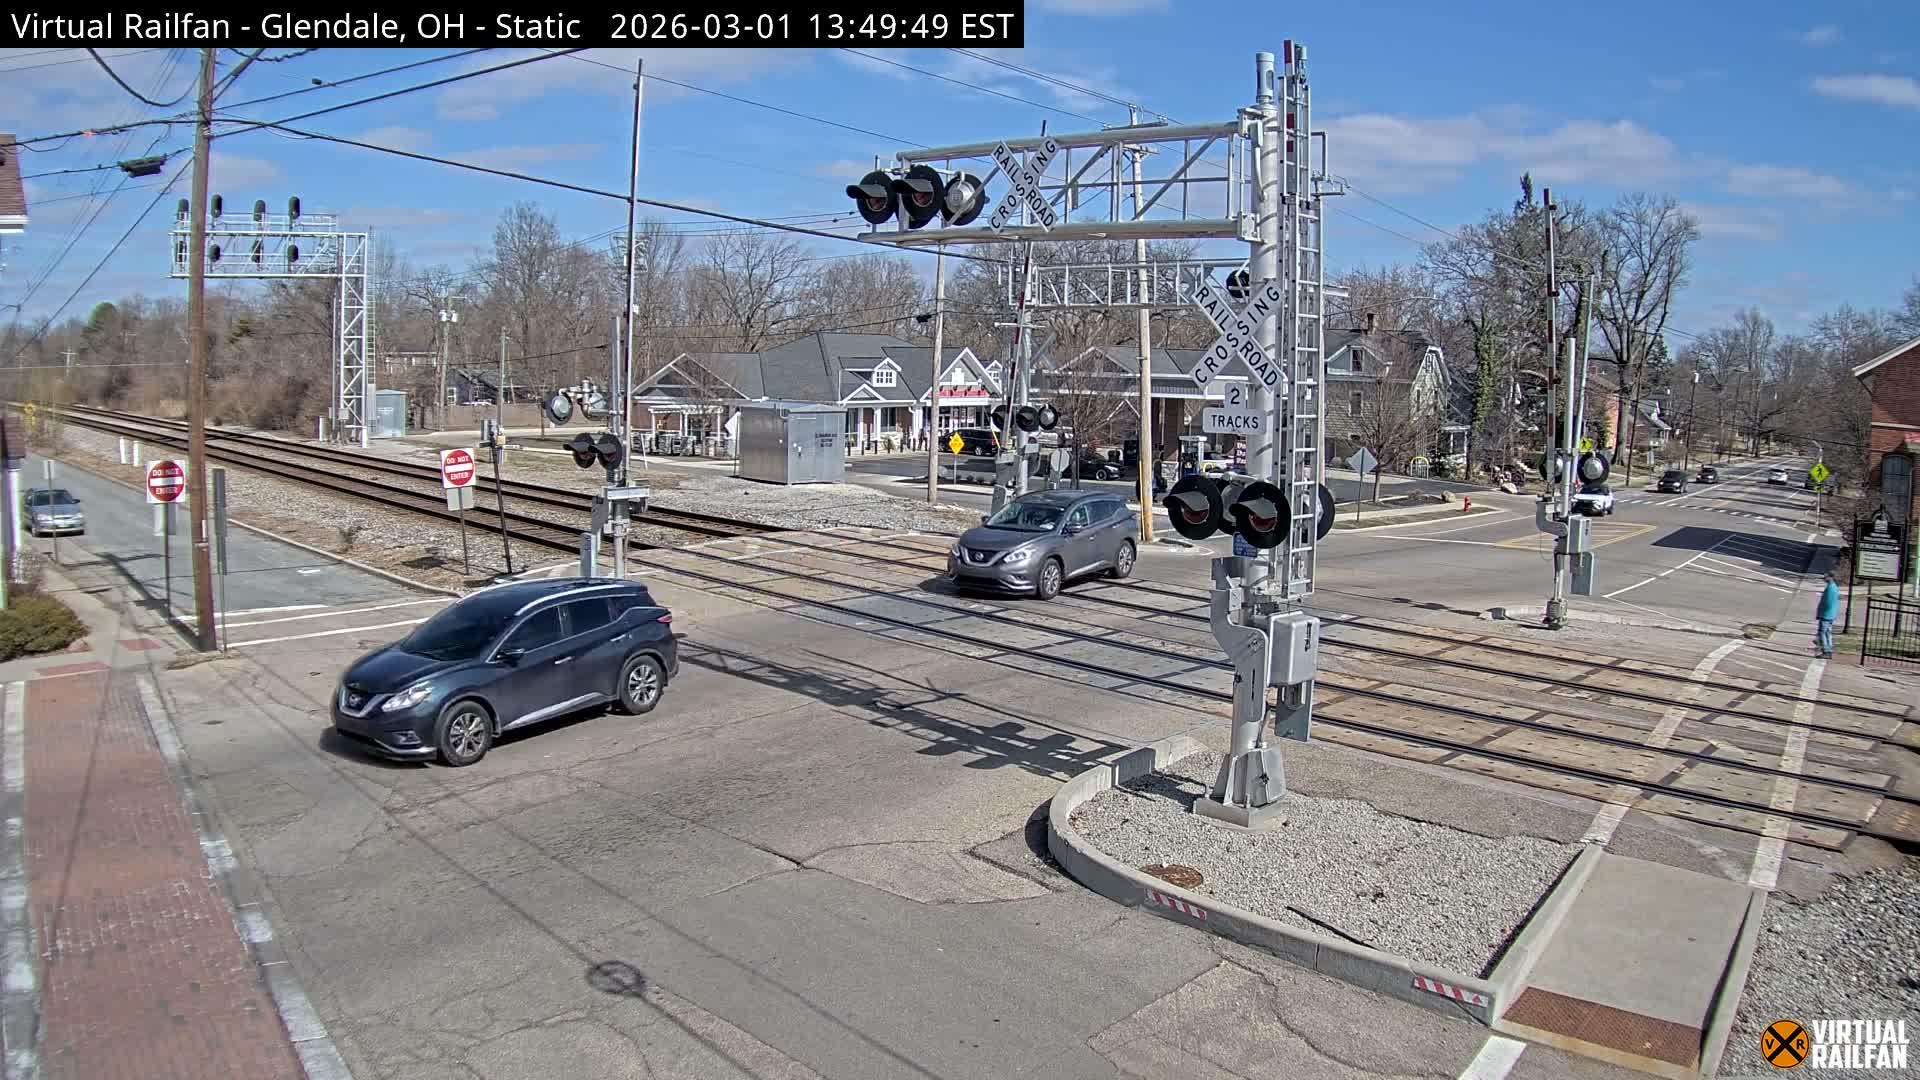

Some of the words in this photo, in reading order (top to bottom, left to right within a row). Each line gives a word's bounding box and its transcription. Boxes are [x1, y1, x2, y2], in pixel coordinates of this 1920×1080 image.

[991, 140, 1056, 229] CROSSING
[1194, 286, 1281, 384] CROSSING
[1211, 414, 1259, 429] TRACKS
[1230, 387, 1241, 405] 2
